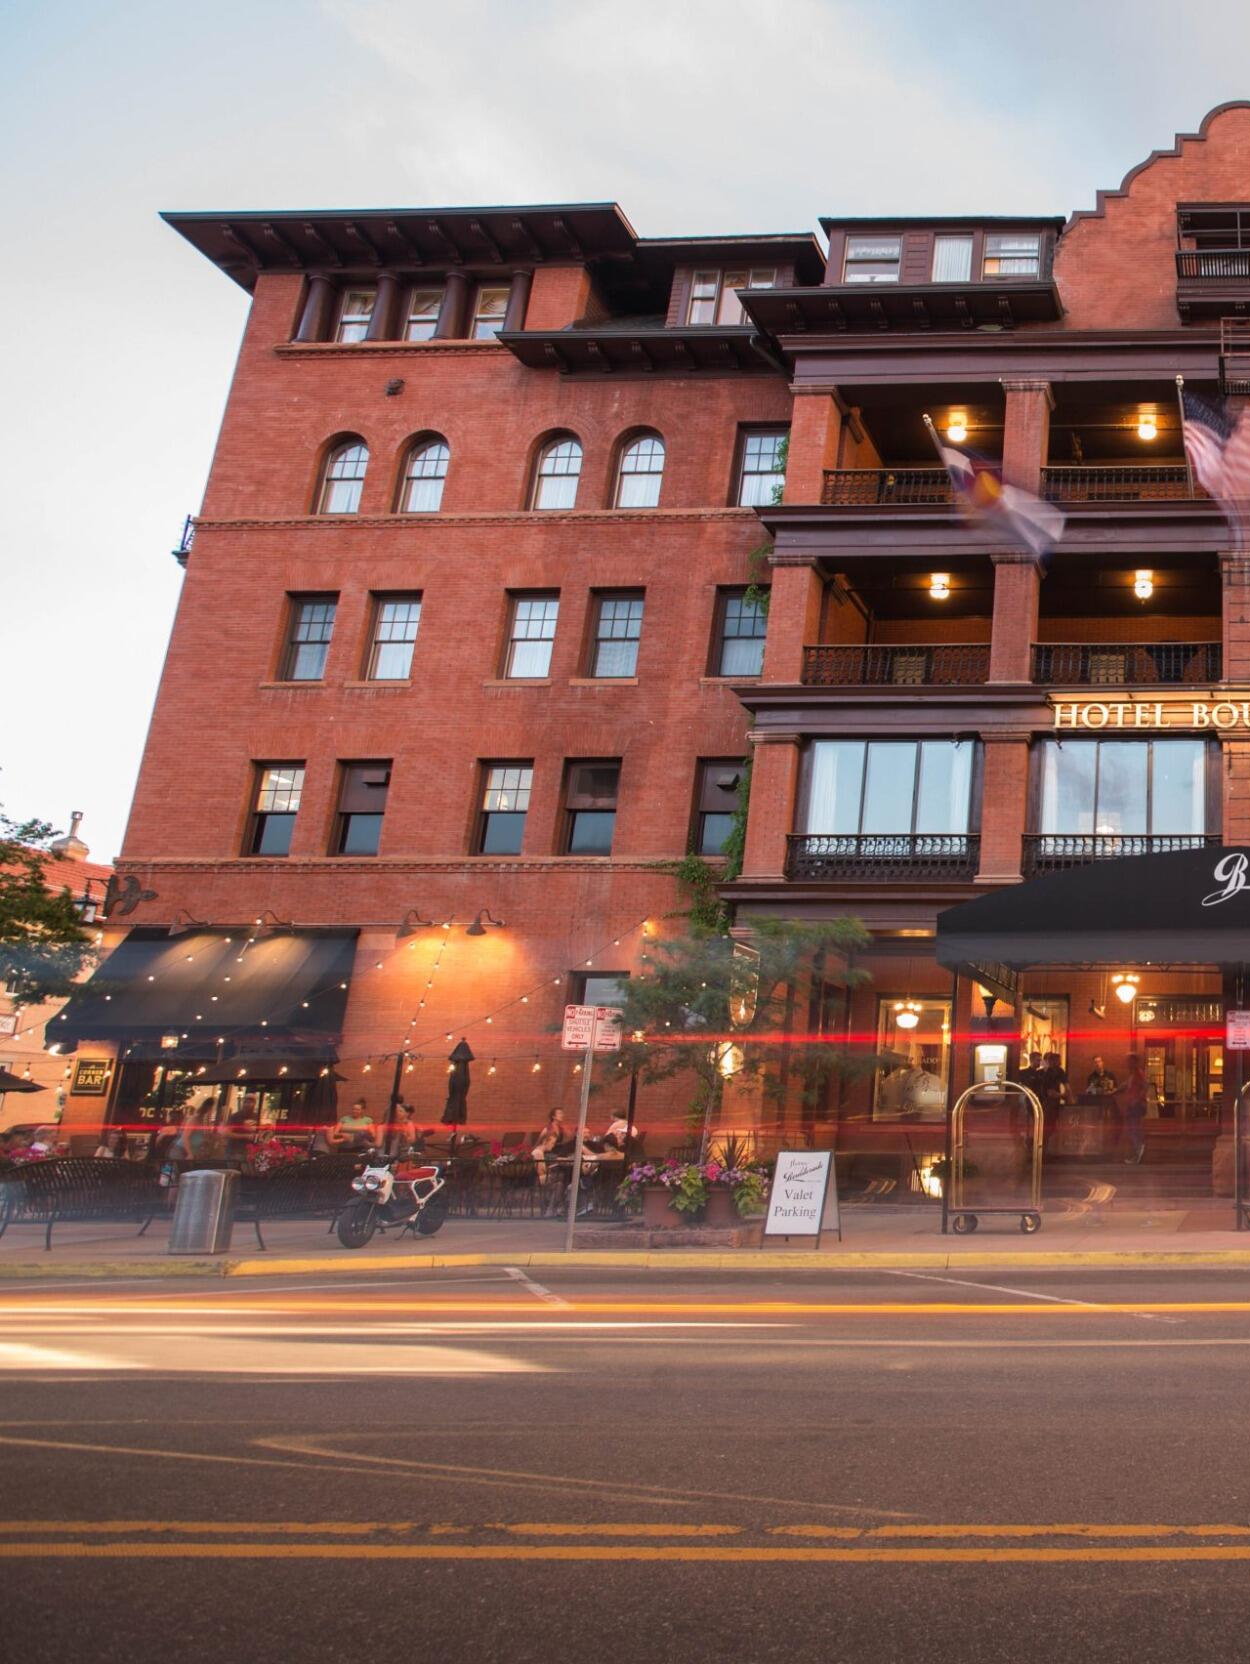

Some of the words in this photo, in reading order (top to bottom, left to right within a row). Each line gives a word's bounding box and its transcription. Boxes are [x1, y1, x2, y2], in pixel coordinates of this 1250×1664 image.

[1053, 703, 1170, 728] HOTEL
[77, 1075, 102, 1085] BAR
[785, 1189, 813, 1200] Valet
[774, 1206, 817, 1219] Parking
